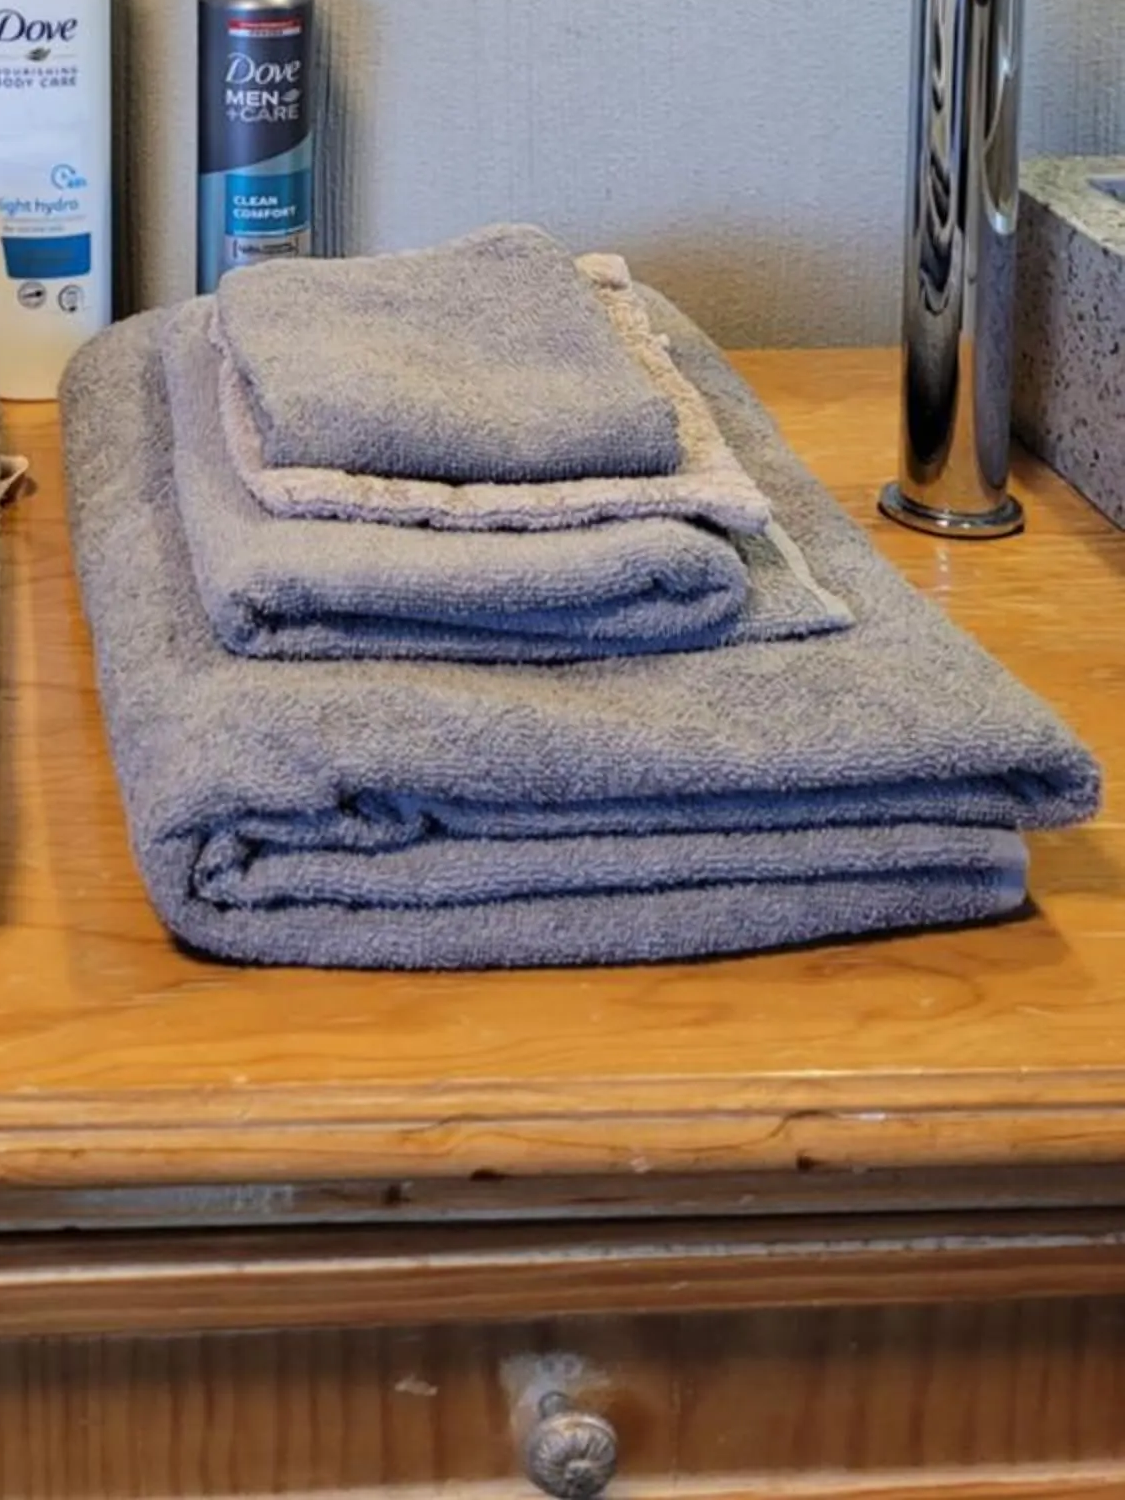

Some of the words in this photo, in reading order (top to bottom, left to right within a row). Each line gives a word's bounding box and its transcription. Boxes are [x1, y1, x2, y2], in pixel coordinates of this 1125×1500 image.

[225, 52, 301, 85] Dove
[39, 76, 77, 88] CARE
[225, 89, 279, 107] MEN
[34, 197, 80, 214] hydro
[232, 195, 279, 206] CLEAN
[232, 205, 297, 220] COMFORT
